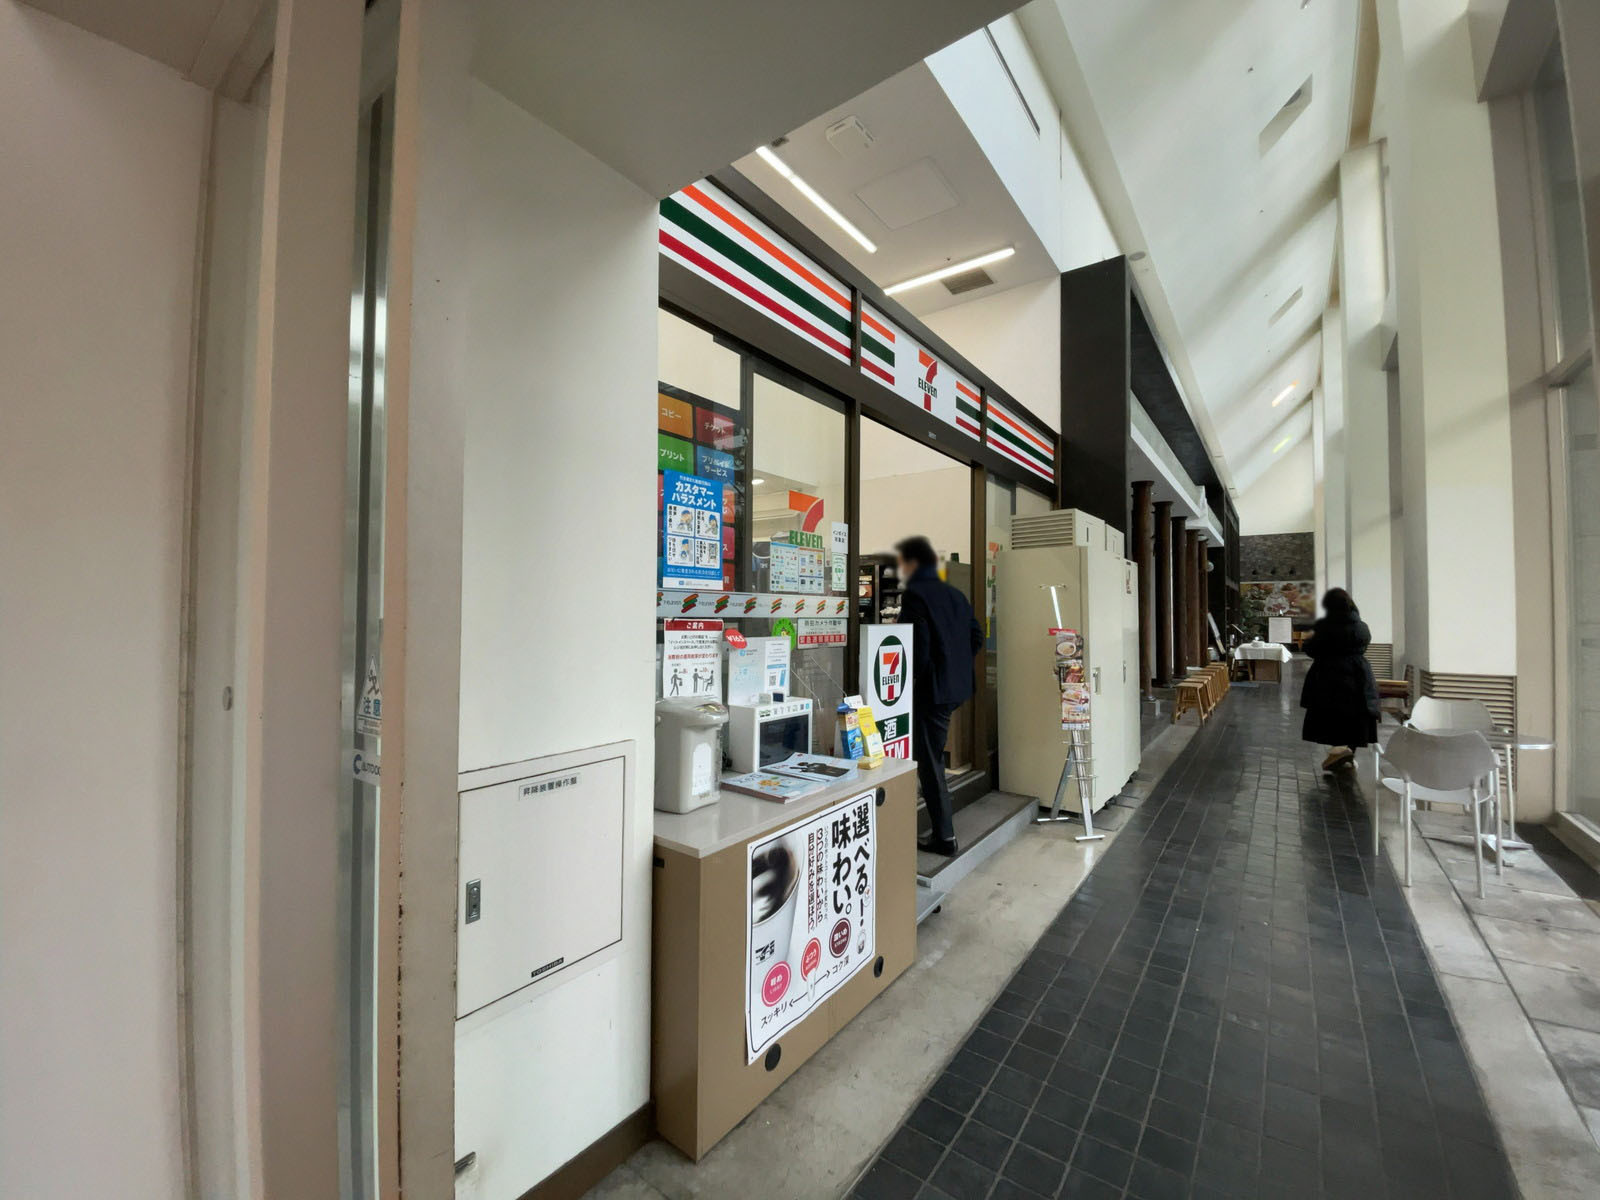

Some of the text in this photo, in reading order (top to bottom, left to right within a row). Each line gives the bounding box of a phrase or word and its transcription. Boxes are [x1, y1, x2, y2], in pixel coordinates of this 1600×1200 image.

[661, 407, 682, 419] コピー
[660, 448, 685, 462] プリント
[704, 466, 728, 478] サービス
[675, 481, 715, 497] カスタマー
[672, 492, 717, 510] ハラスメント
[884, 717, 898, 741] 酒
[885, 741, 905, 759] TM
[523, 776, 578, 797] 昇降装置操作盤
[761, 1000, 788, 1029] スッキリ
